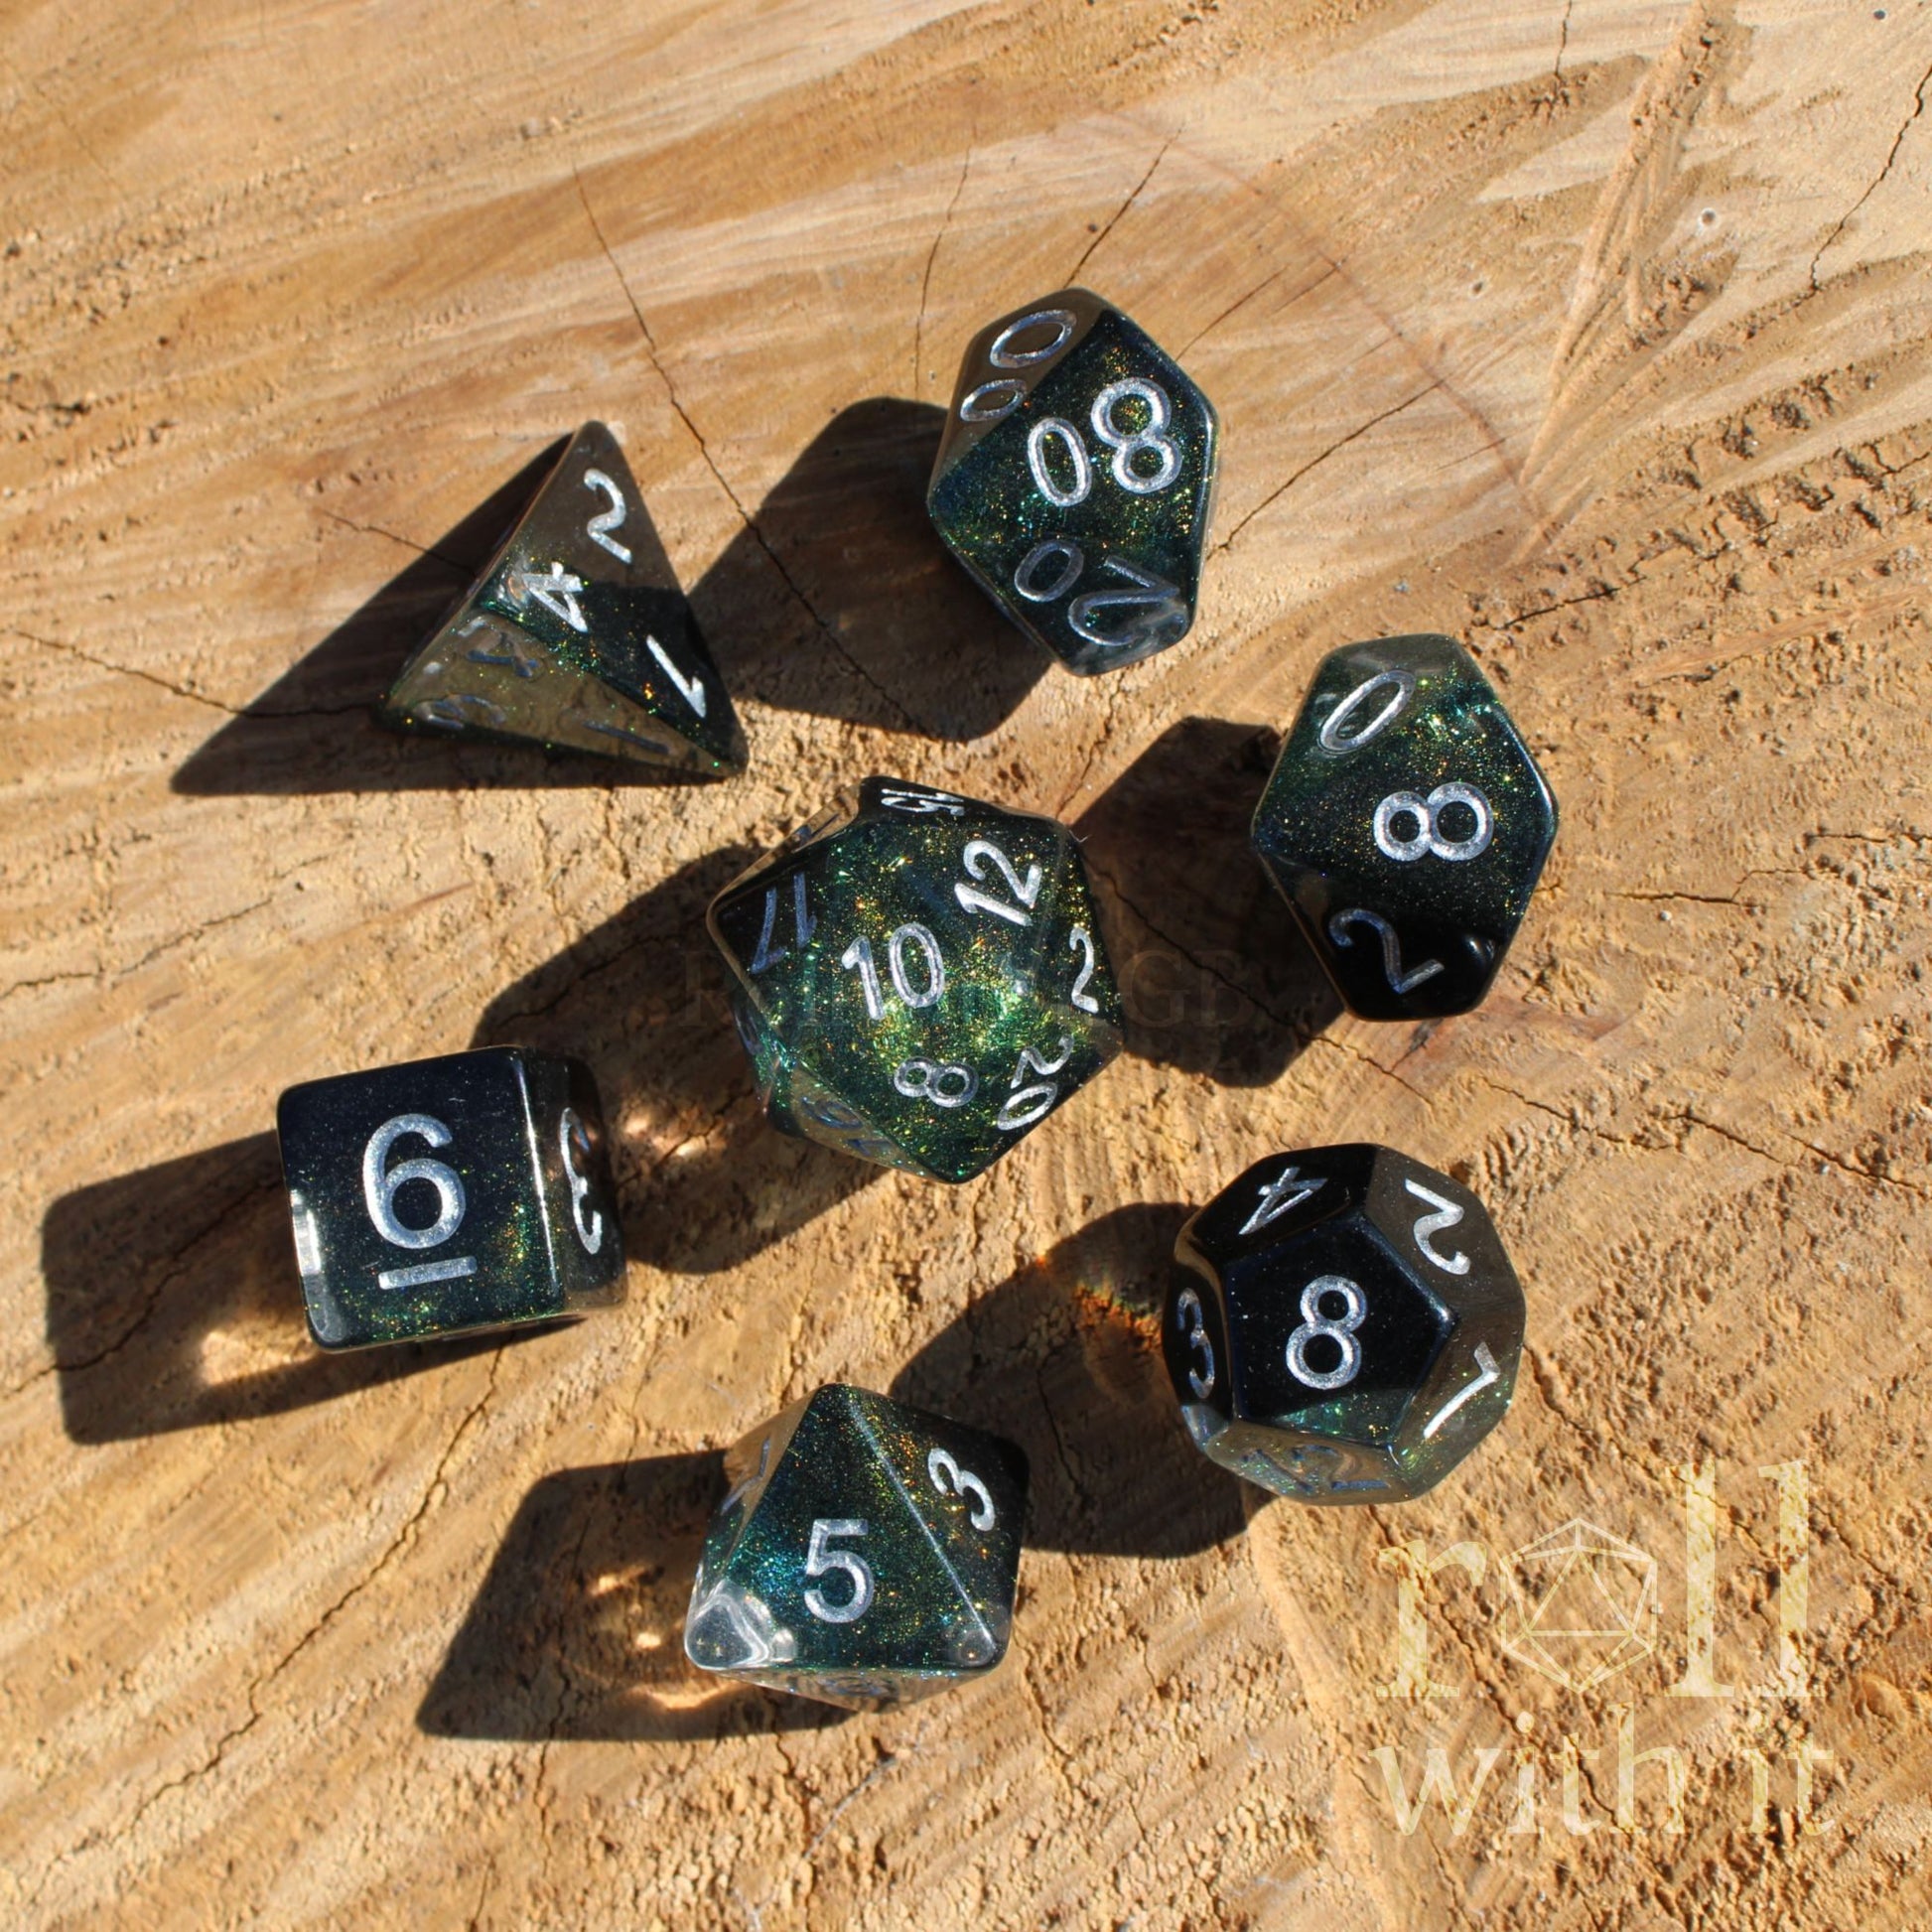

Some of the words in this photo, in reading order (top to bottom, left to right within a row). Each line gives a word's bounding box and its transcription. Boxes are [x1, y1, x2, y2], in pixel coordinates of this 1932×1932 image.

[584, 468, 632, 565] 2
[520, 560, 589, 632] 4
[645, 633, 707, 718] 1
[1318, 669, 1416, 752] 0
[1373, 781, 1494, 862] 8
[953, 840, 1042, 926] 12
[841, 922, 945, 1021] 10
[1068, 926, 1098, 1014] 2
[1328, 907, 1445, 995] 2
[894, 1055, 979, 1108] 8
[996, 1035, 1074, 1131] 20
[361, 1112, 477, 1291] 6
[1238, 1166, 1328, 1236] 4
[1404, 1177, 1471, 1276] 2
[1176, 1287, 1215, 1399] 3
[1286, 1274, 1368, 1390] 8
[926, 1448, 995, 1532] 3
[802, 1518, 875, 1623] 5
